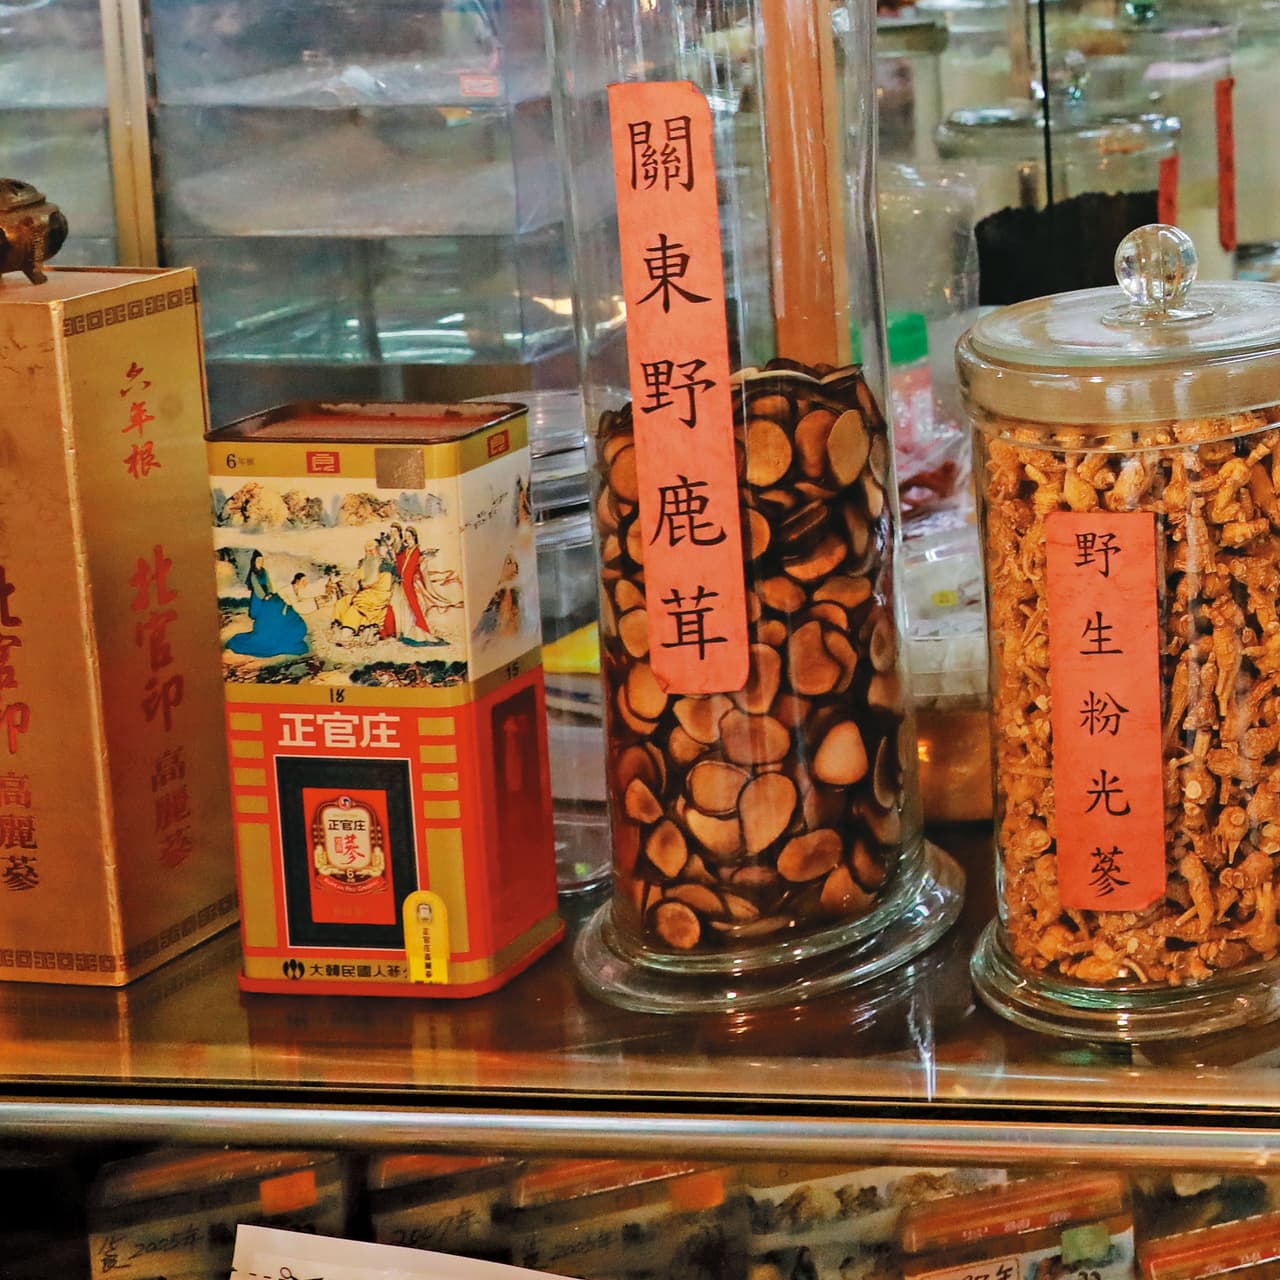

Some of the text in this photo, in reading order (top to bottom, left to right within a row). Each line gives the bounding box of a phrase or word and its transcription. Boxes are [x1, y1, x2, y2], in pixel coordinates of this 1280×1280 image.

[120, 361, 162, 480] 六年根
[627, 114, 728, 662] 關東野鹿茸
[278, 711, 401, 749] 正官庄
[1073, 531, 1131, 898] 野生粉光蔘
[328, 819, 367, 832] 正官庄
